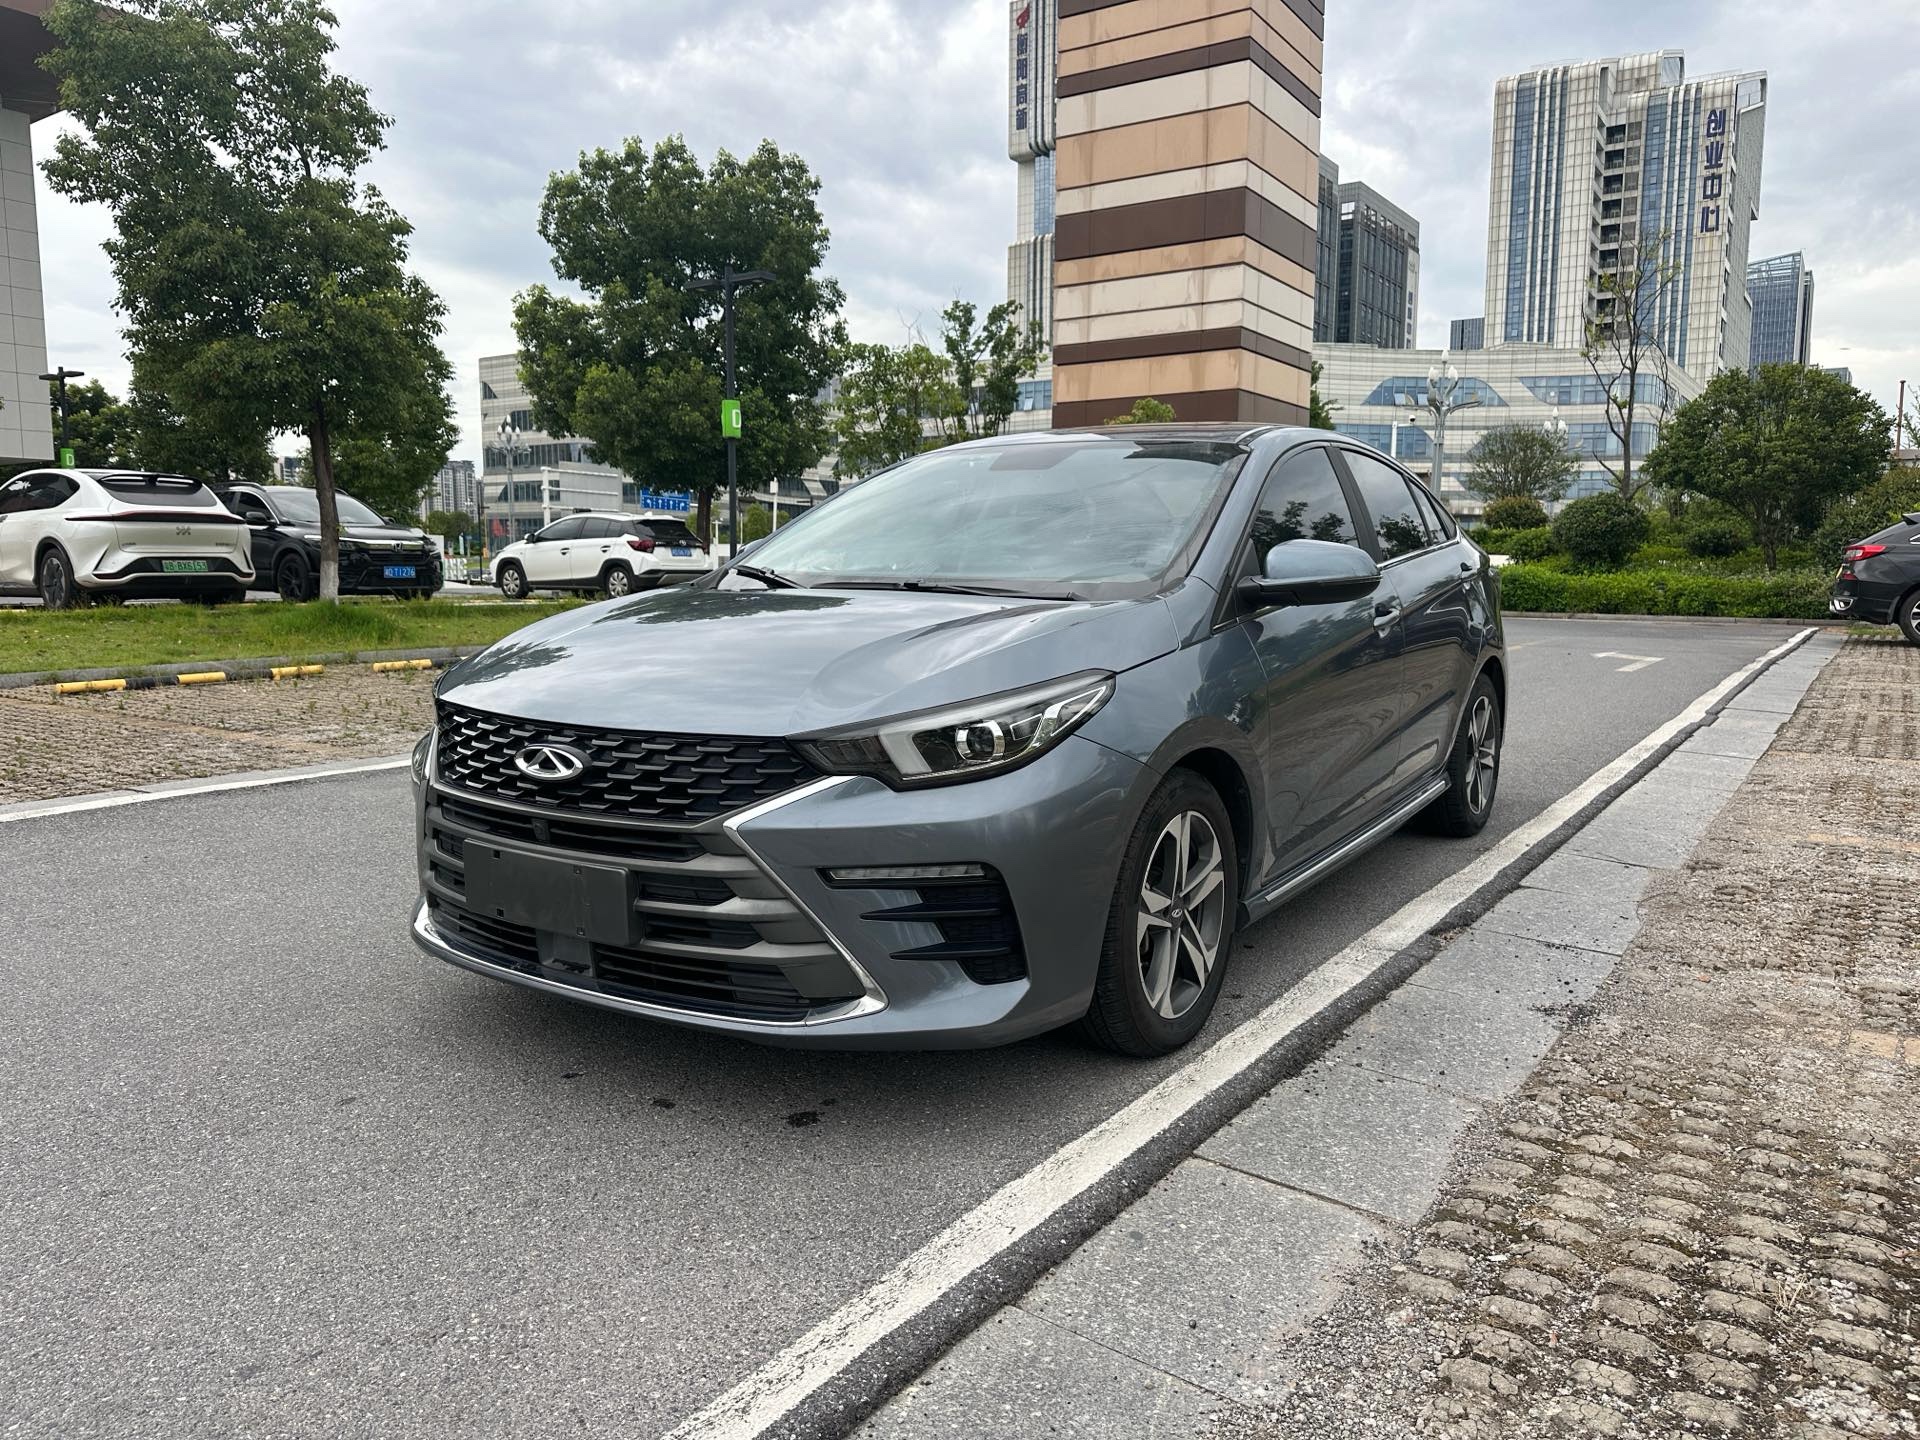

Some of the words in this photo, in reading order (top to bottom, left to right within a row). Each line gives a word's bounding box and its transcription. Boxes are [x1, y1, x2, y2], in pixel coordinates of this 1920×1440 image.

[1700, 108, 1727, 233] 创业中心
[732, 409, 742, 428] D
[66, 453, 75, 466] D
